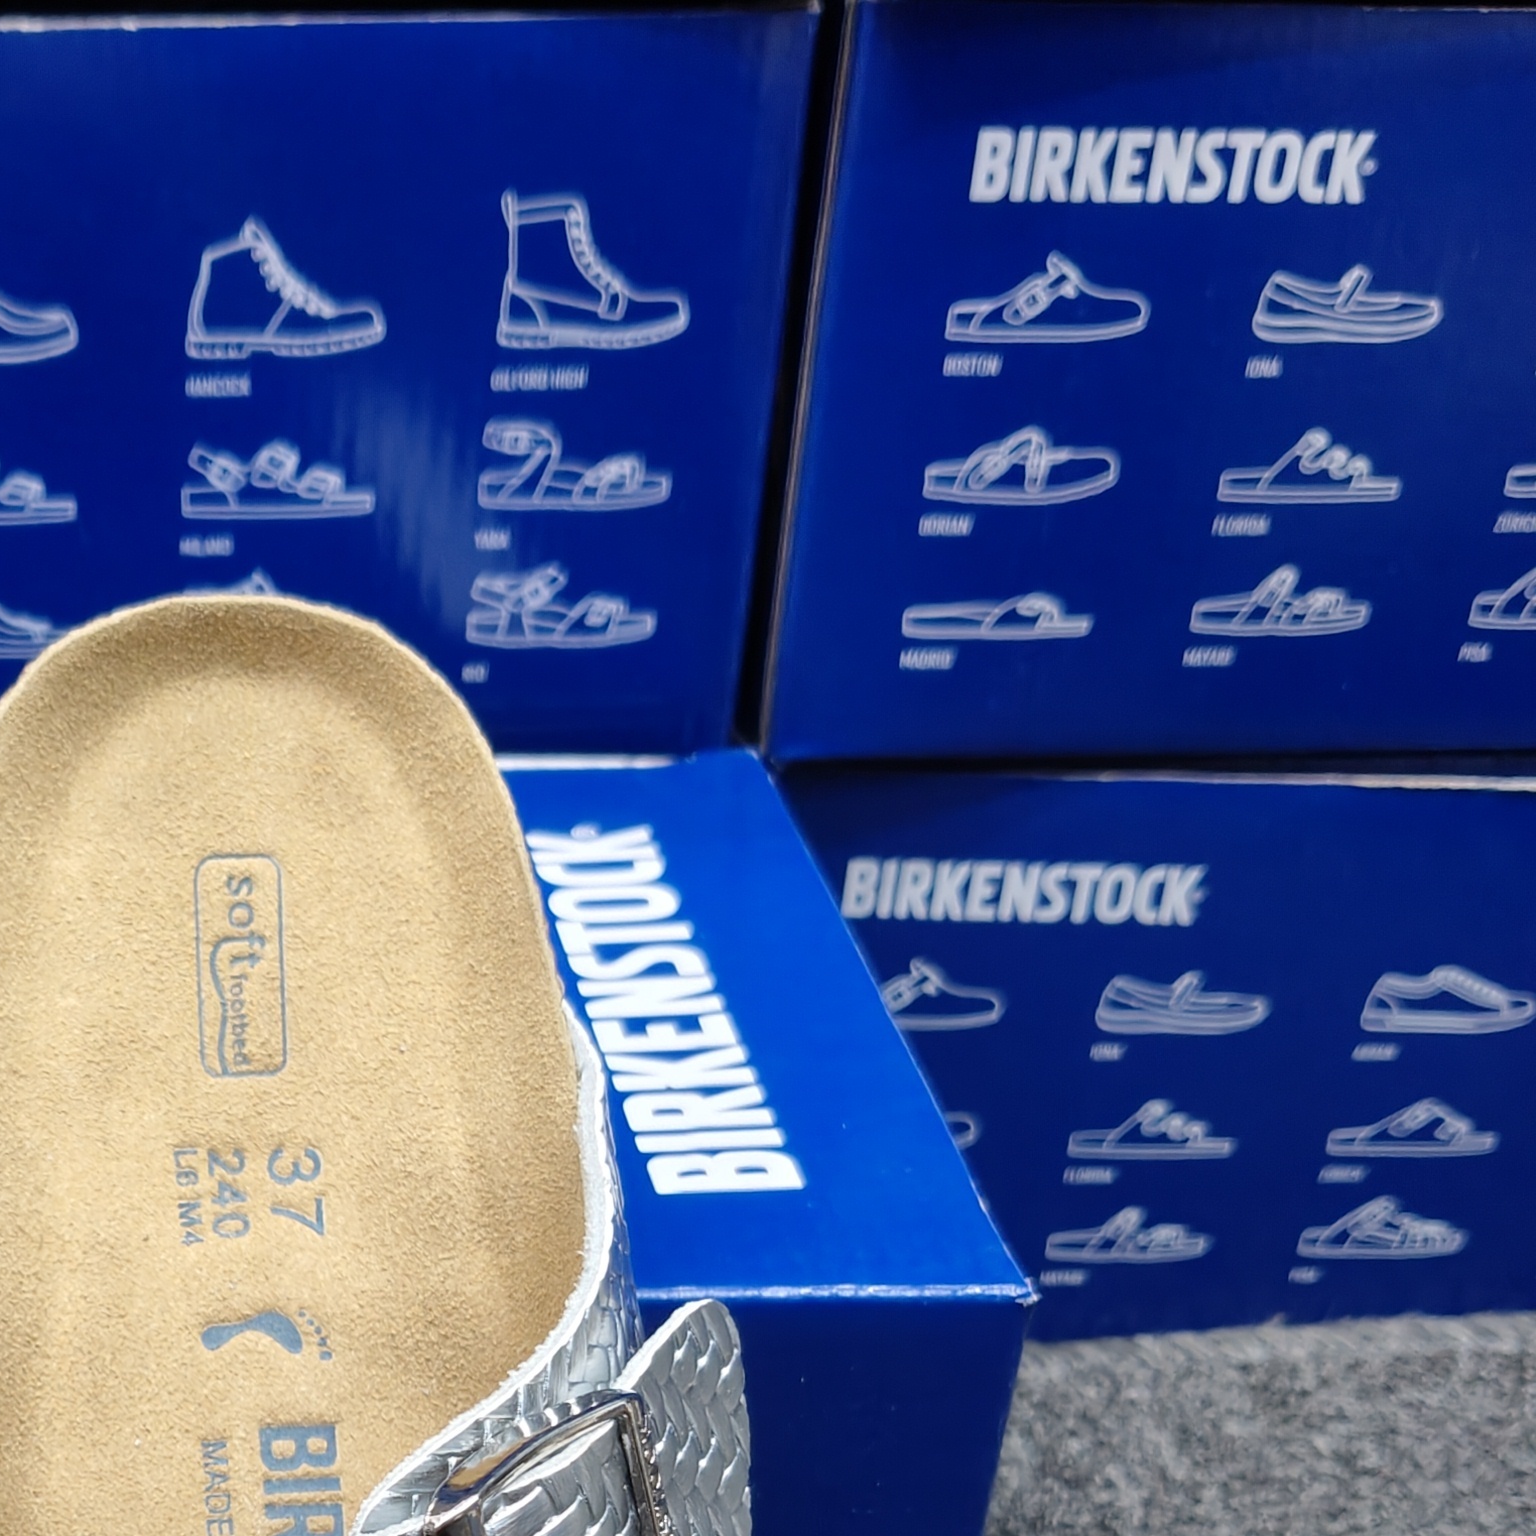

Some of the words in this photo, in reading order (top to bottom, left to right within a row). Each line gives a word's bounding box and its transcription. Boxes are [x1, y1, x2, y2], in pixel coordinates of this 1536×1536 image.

[969, 127, 1377, 204] BIRKENSTOCK
[840, 857, 1206, 927] BIRKENSTOCK
[525, 824, 807, 1196] BIRKENSTOCK
[208, 1146, 252, 1239] 240
[267, 1146, 326, 1236] 37
